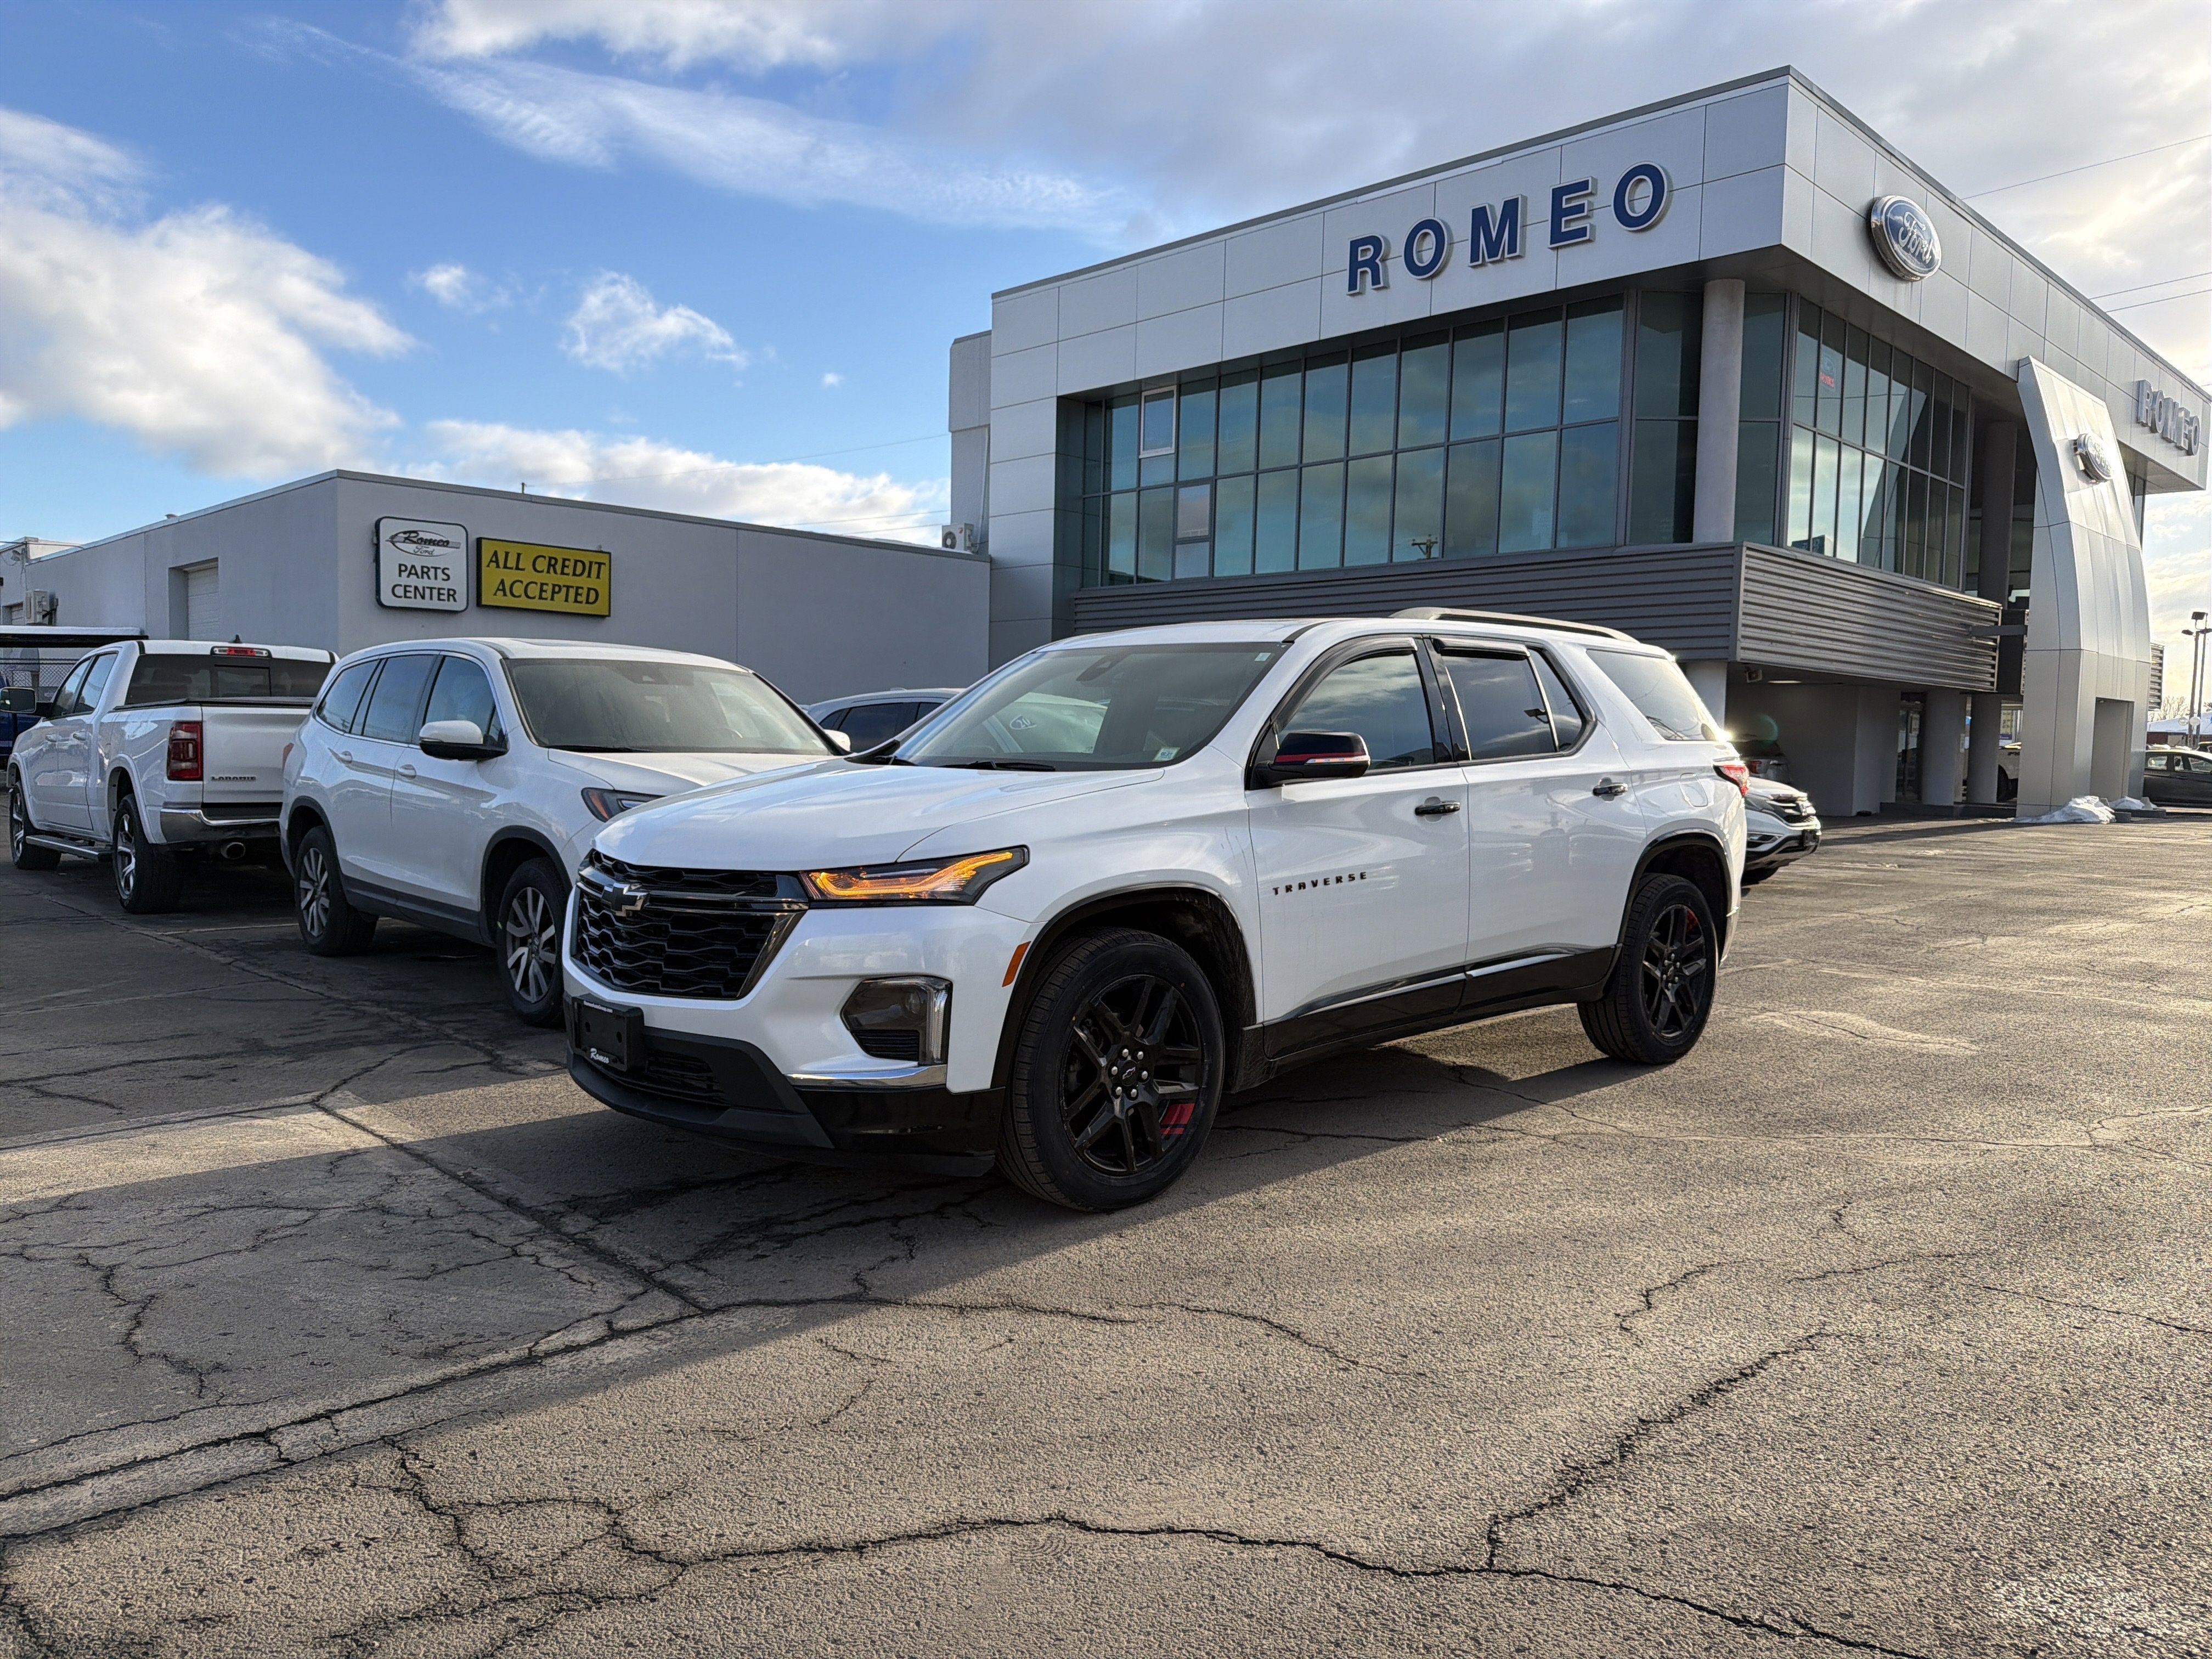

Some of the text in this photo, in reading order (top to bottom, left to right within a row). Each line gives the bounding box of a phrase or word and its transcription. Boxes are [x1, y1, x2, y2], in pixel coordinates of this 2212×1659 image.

[1346, 161, 1669, 295] ROMEO
[1898, 211, 1933, 264] Ford
[2137, 379, 2200, 456] ROMEO
[402, 530, 450, 548] Romeo
[413, 545, 435, 556] Ford
[398, 563, 451, 582] PARTS
[486, 550, 606, 579] ALL CREDIT
[391, 583, 458, 603] CENTER
[493, 578, 600, 605] ACCEPTED
[1272, 871, 1367, 895] TRAVERSE
